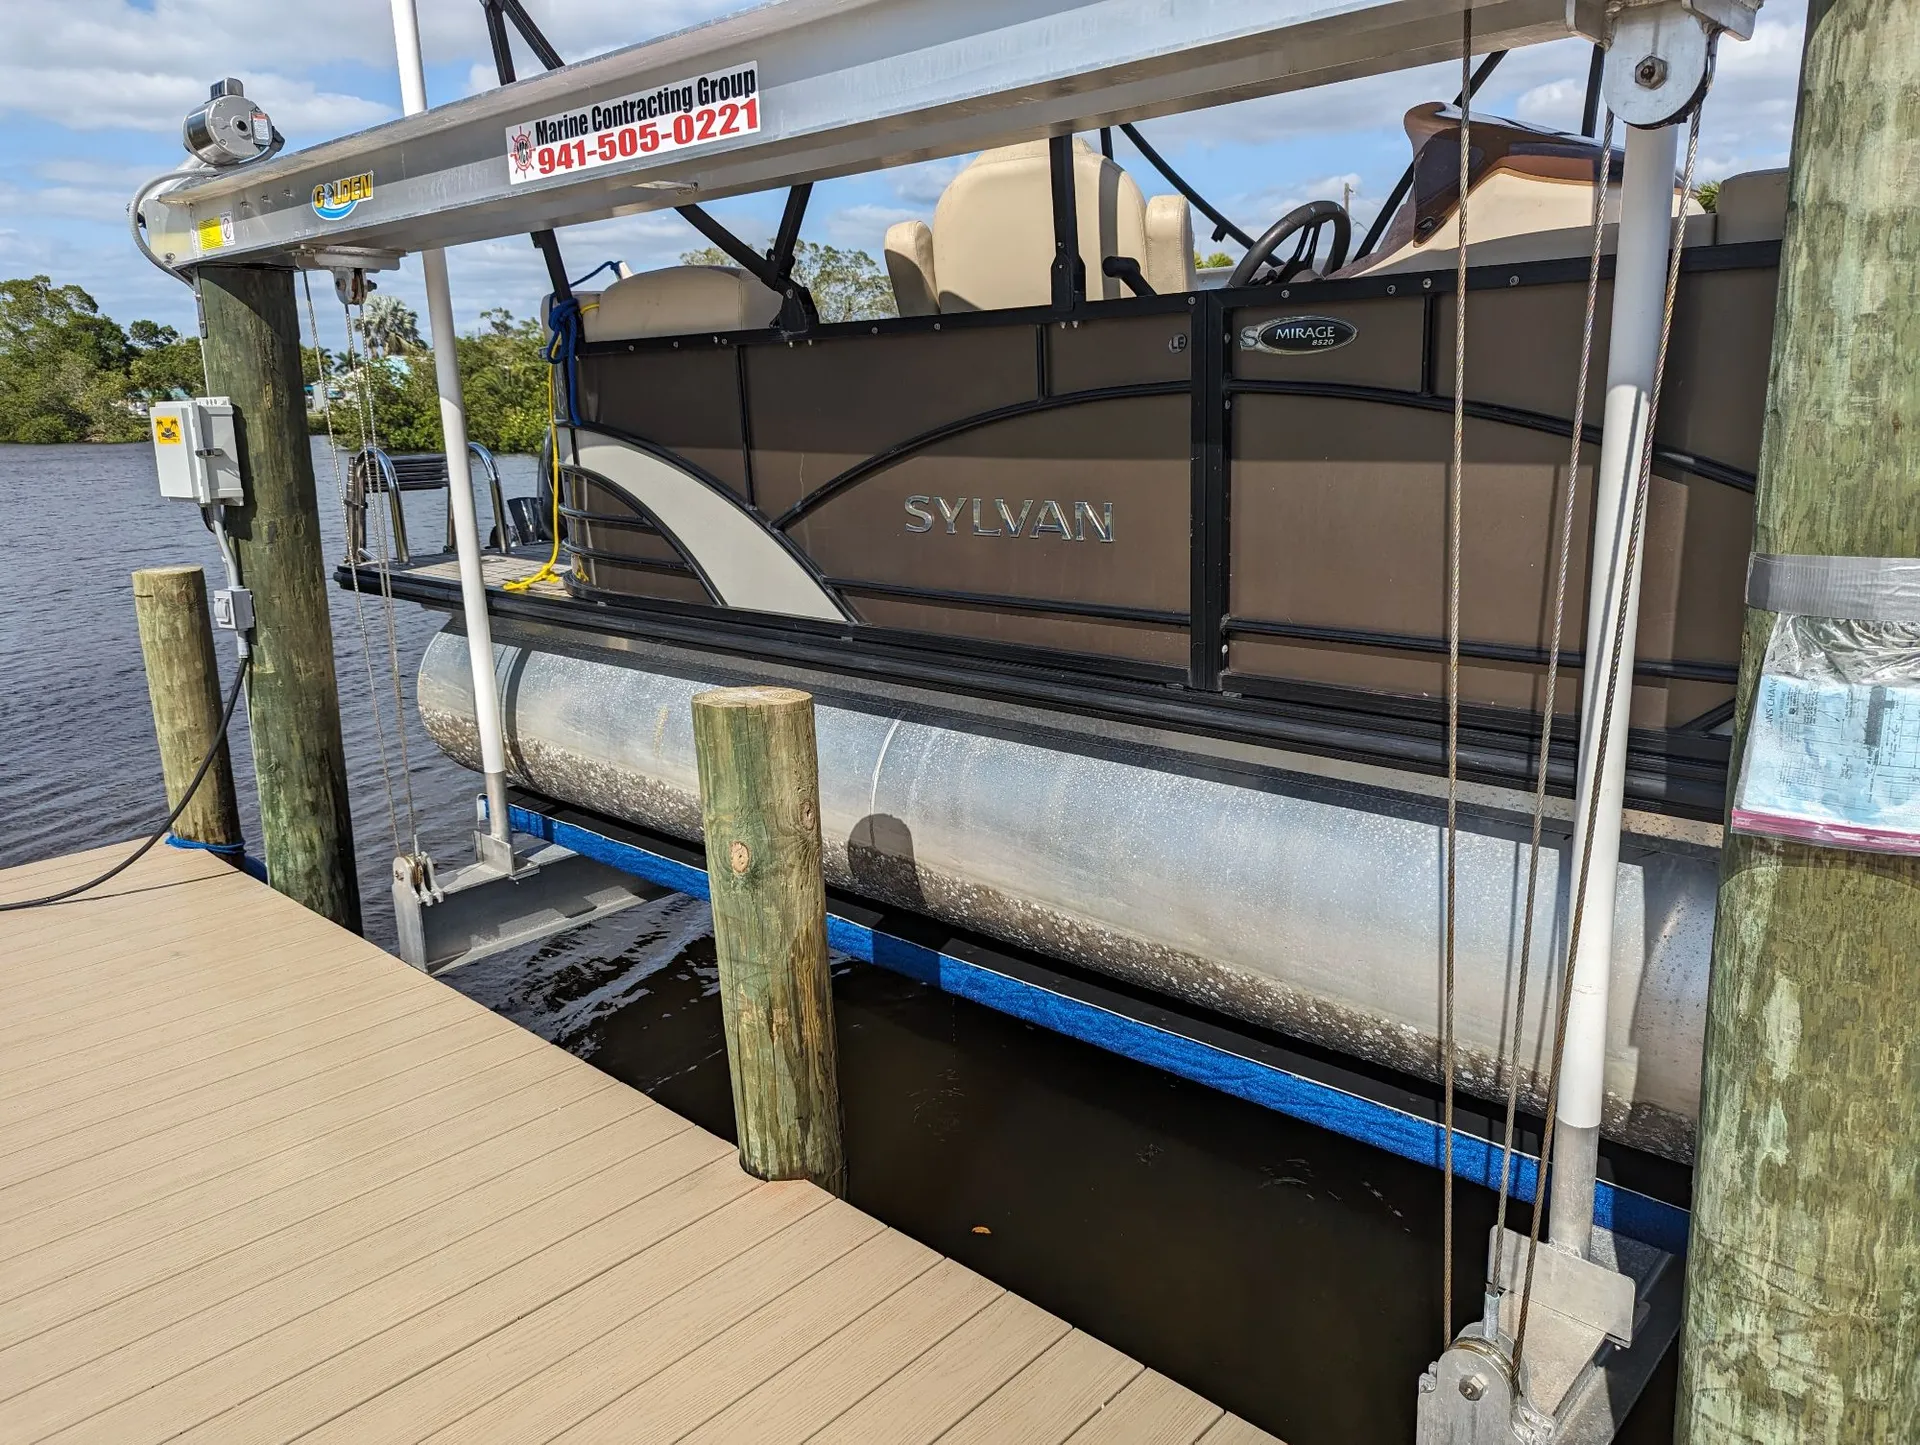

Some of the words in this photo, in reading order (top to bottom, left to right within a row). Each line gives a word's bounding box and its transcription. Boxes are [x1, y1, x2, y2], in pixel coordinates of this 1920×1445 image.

[535, 115, 588, 147] Marine
[592, 83, 692, 132] Contracting
[697, 69, 756, 106] Group
[538, 98, 758, 175] 941-505-0221
[314, 174, 372, 208] GOLDEN
[1275, 326, 1336, 340] MIRAGE
[1311, 338, 1335, 346] 8520
[904, 494, 1114, 543] SYLVAN
